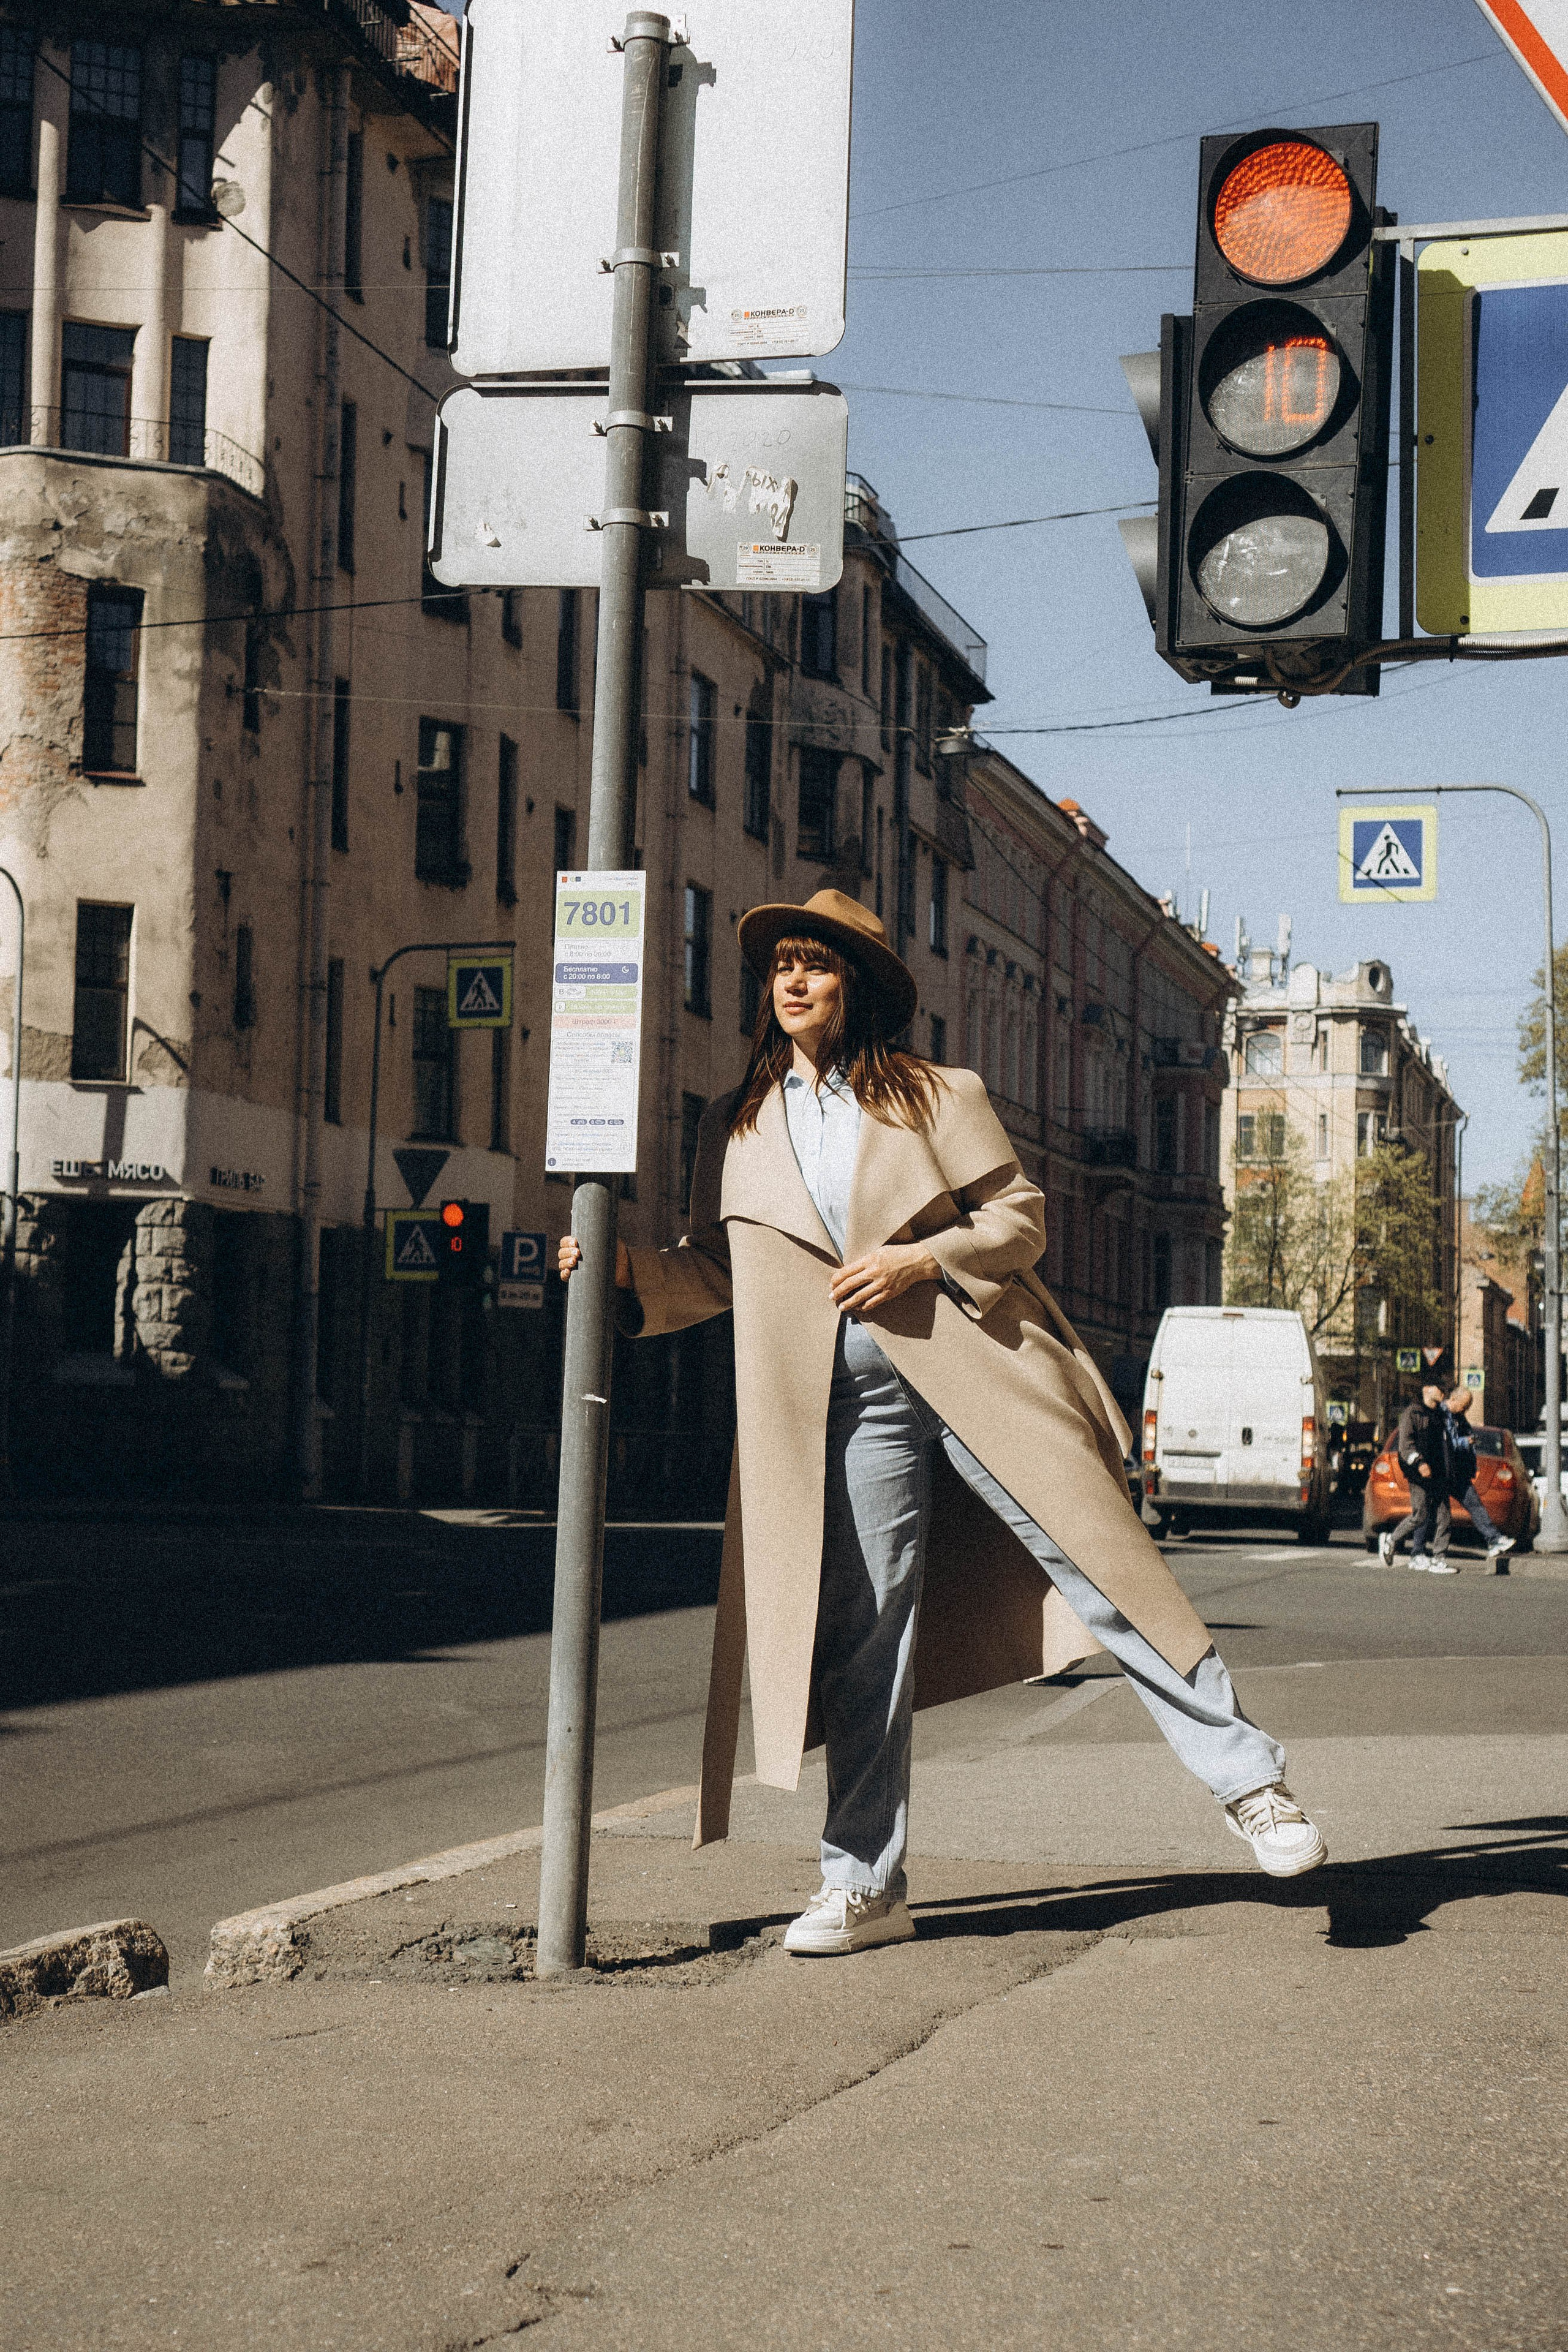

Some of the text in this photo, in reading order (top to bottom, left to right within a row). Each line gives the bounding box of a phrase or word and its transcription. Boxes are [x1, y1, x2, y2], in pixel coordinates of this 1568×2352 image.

[1264, 335, 1329, 424] 10
[564, 901, 630, 926] 7801
[108, 1159, 165, 1181] МЯСО
[450, 1237, 462, 1252] 10
[513, 1237, 539, 1275] P
